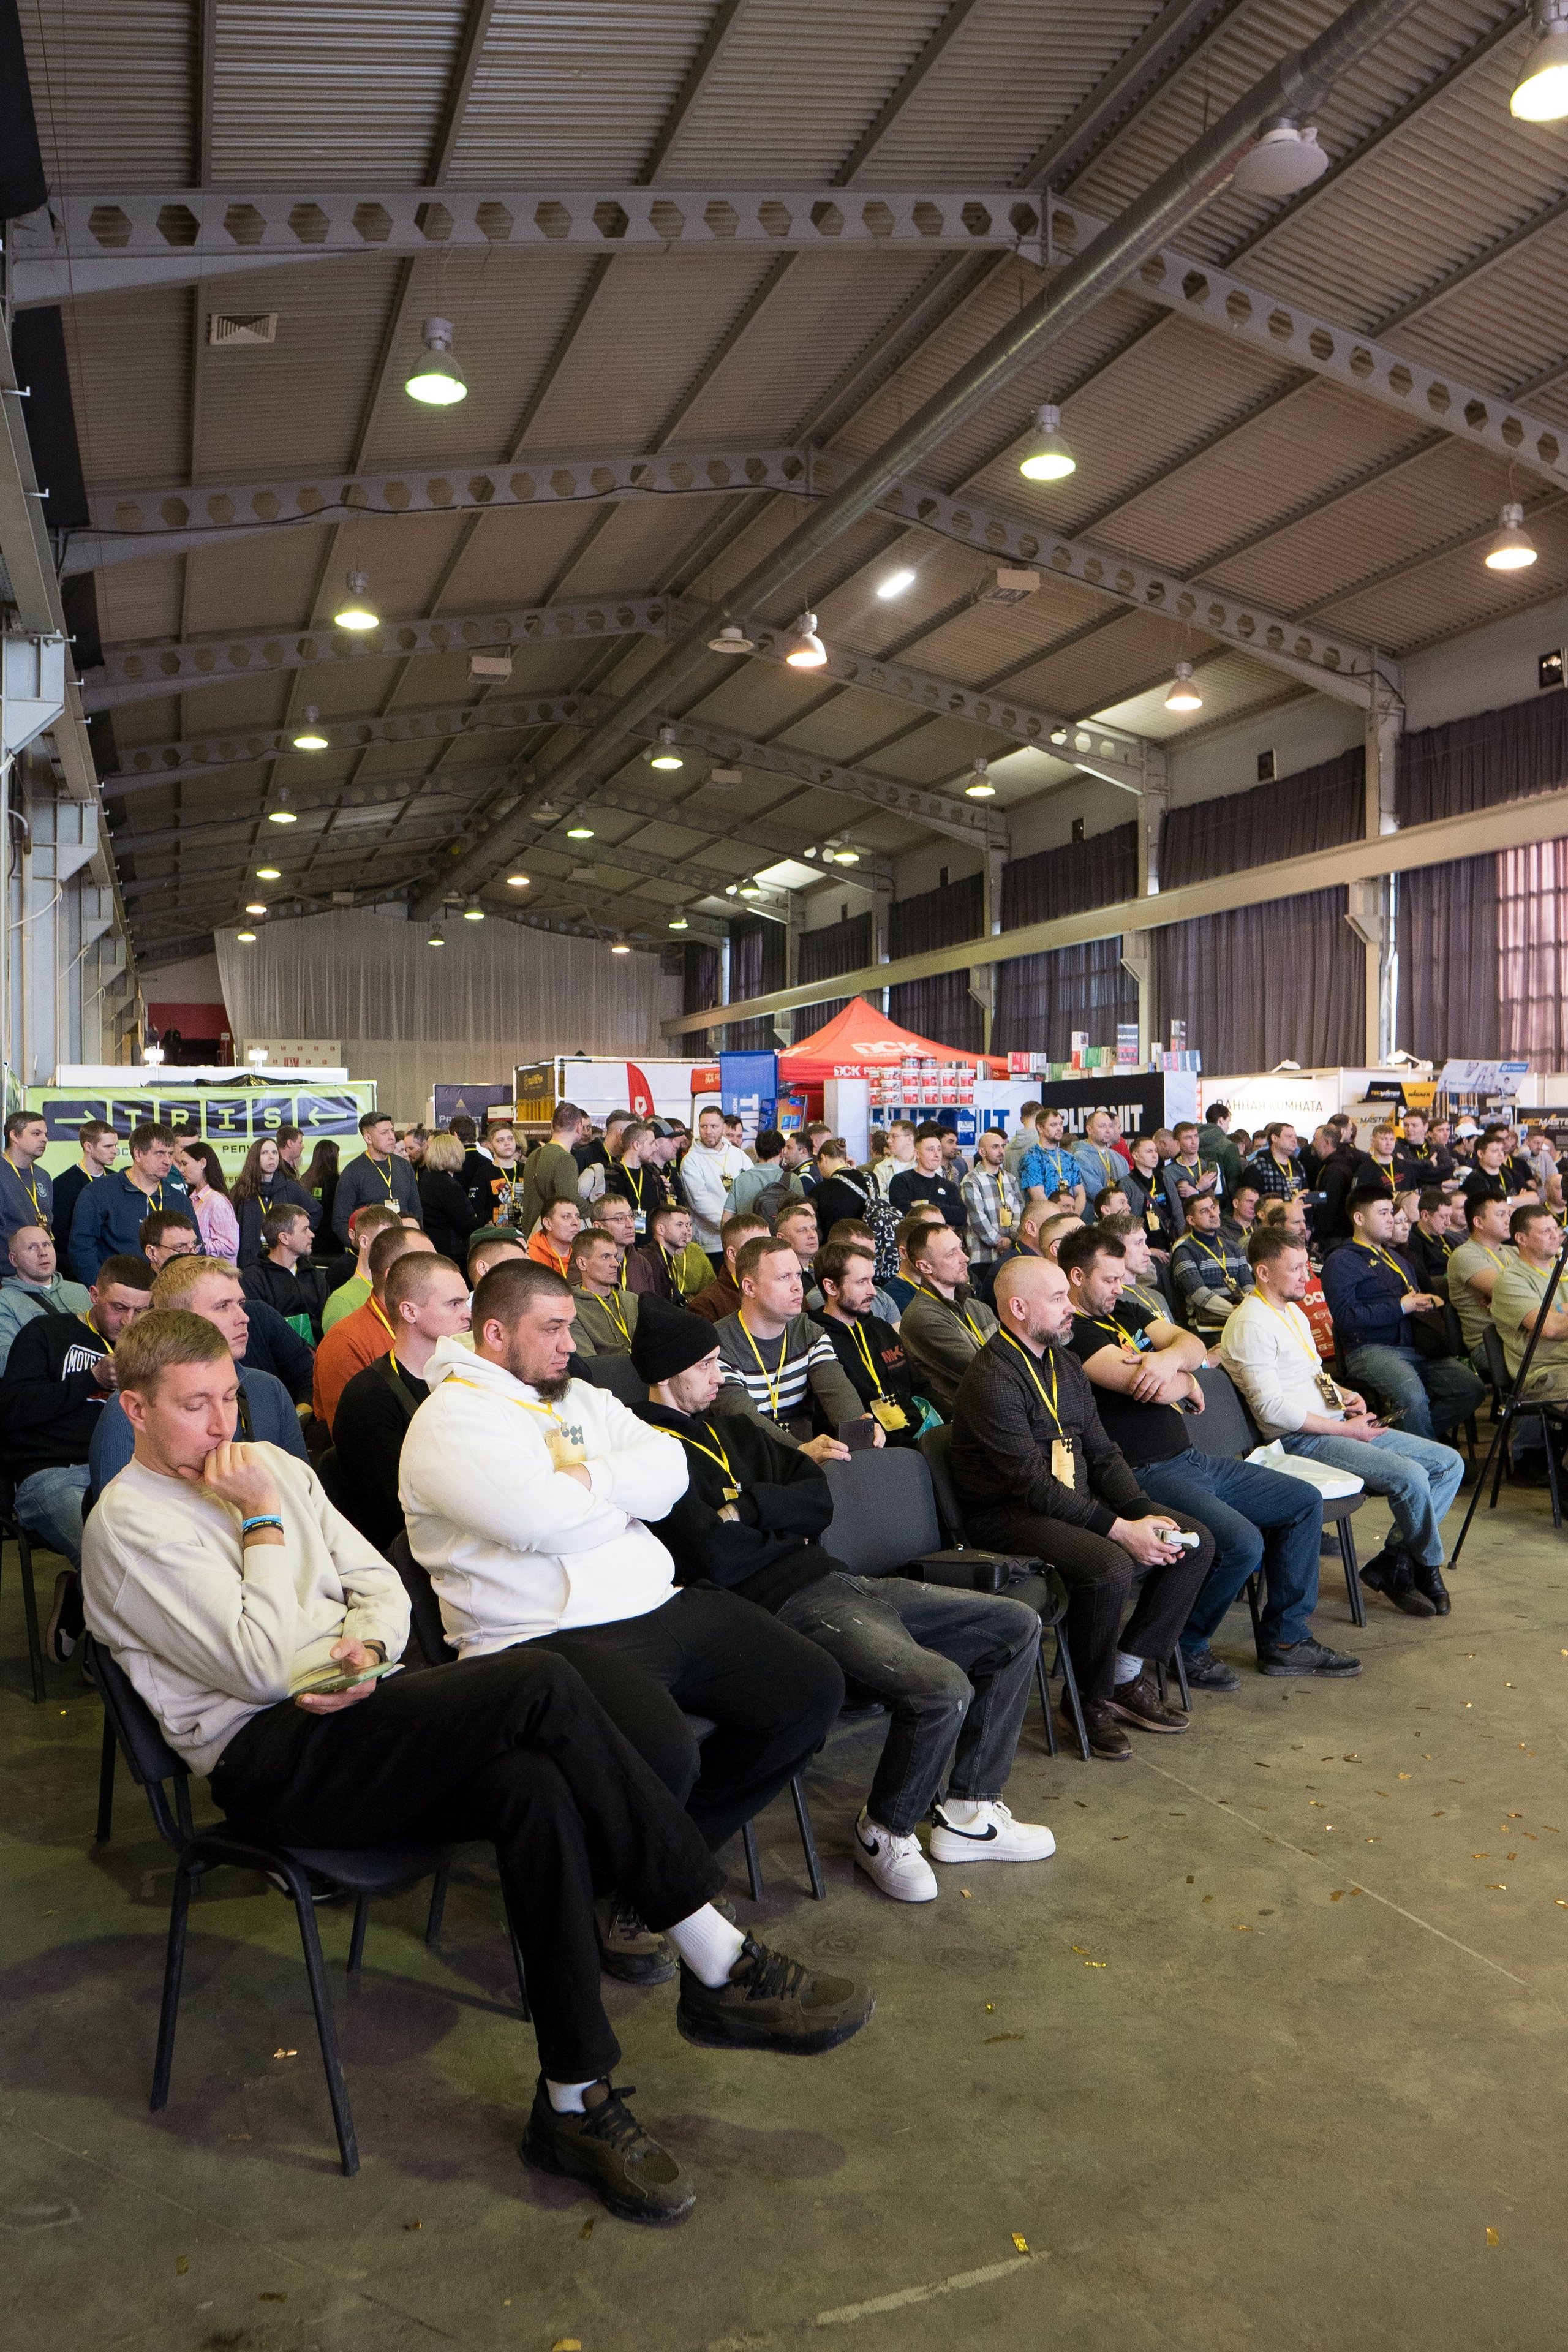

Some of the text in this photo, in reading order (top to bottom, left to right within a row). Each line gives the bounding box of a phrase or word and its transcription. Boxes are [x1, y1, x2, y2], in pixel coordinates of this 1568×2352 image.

[851, 1041, 929, 1054] DCK
[834, 1065, 861, 1077] DCK
[124, 1107, 282, 1131] TRIS
